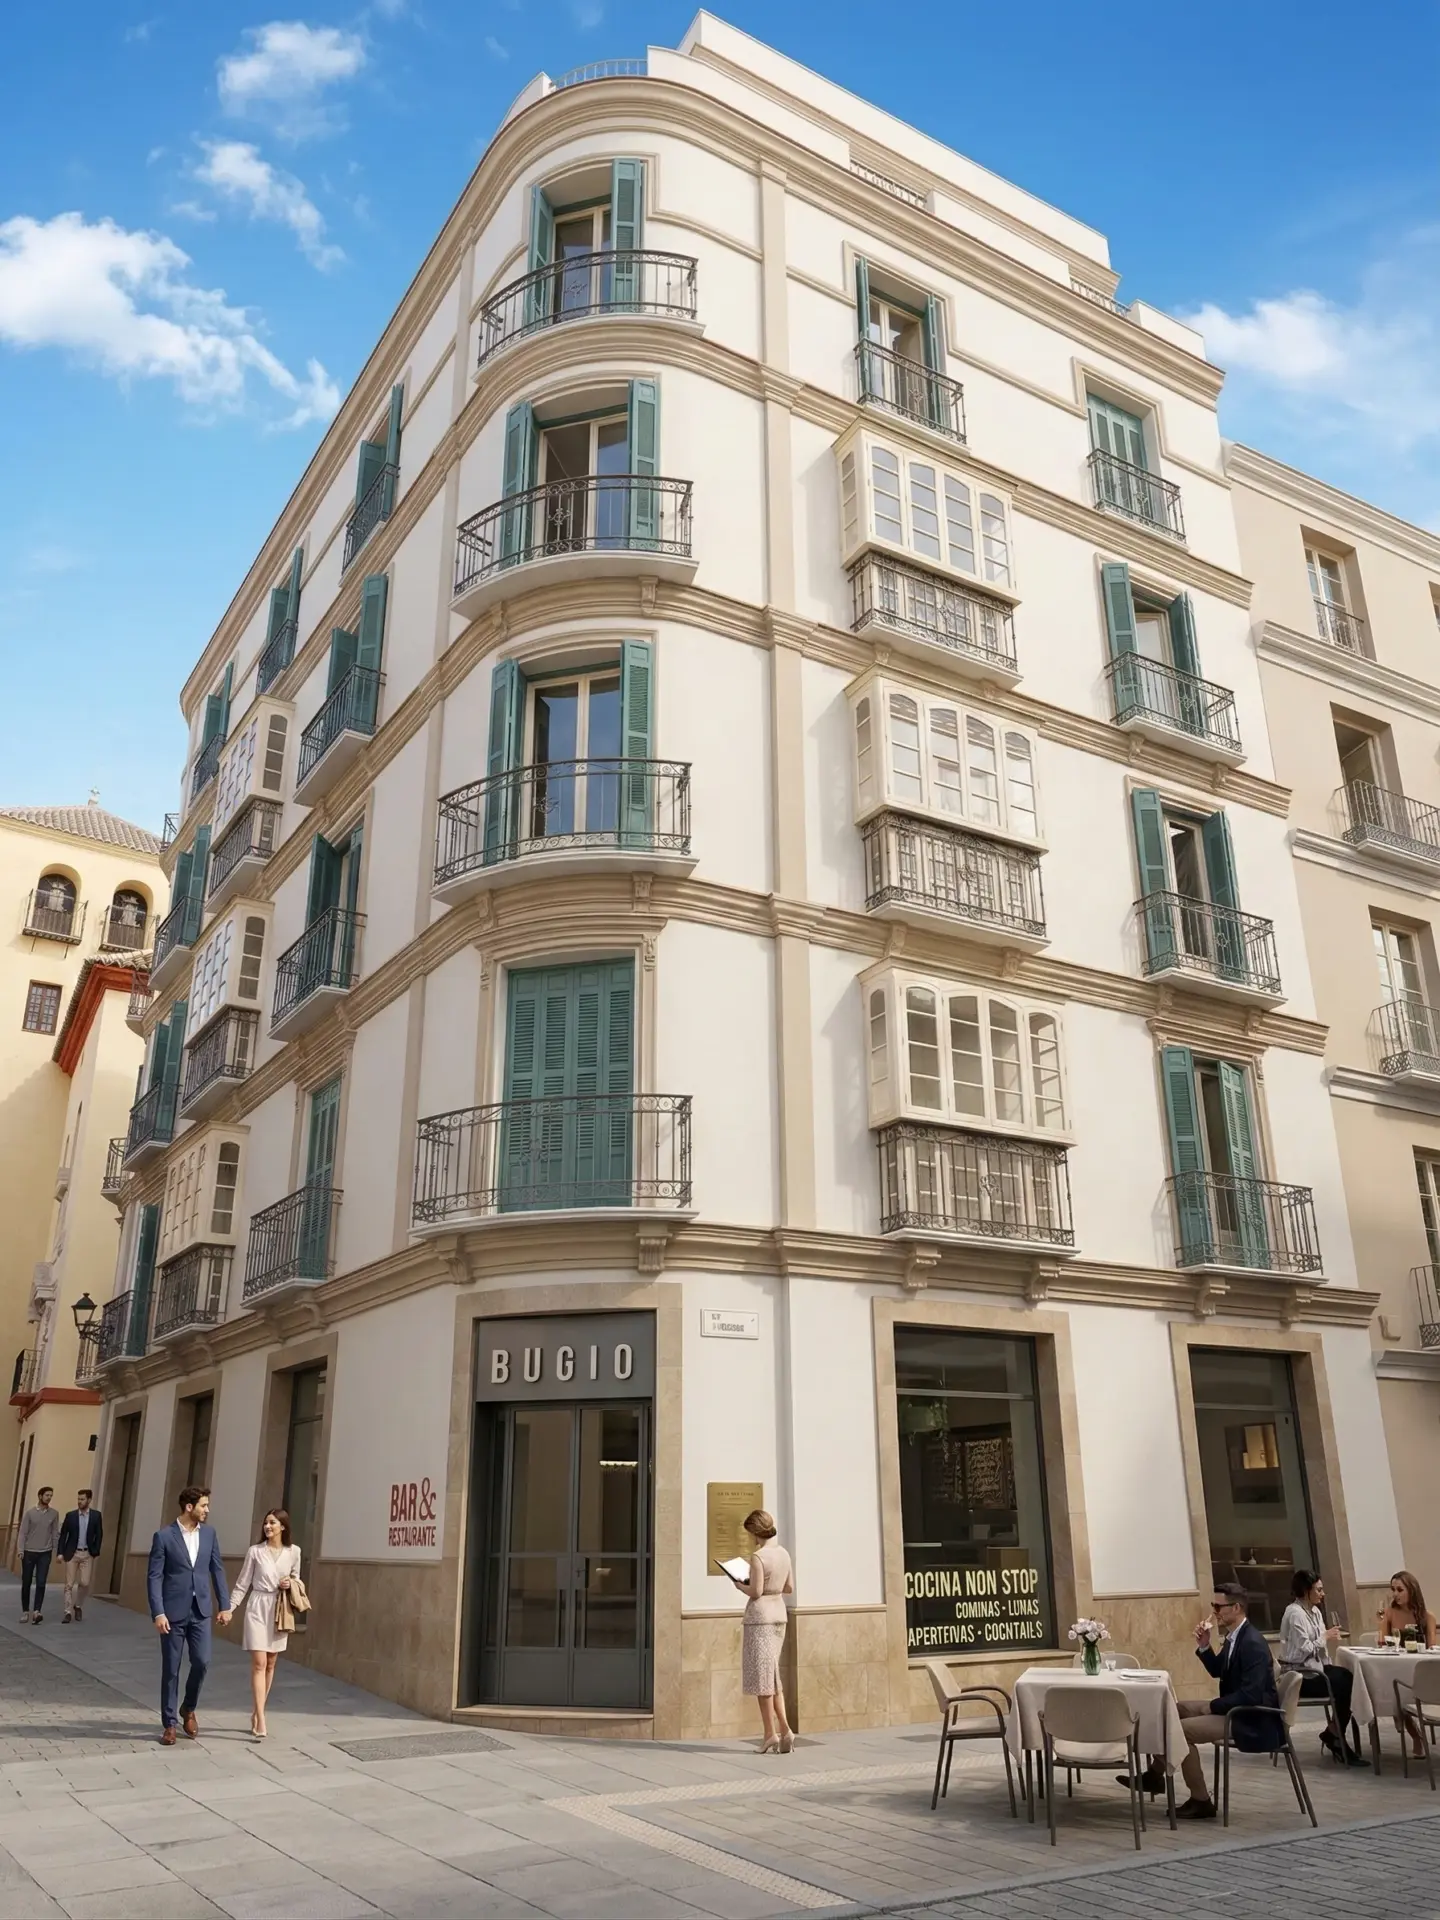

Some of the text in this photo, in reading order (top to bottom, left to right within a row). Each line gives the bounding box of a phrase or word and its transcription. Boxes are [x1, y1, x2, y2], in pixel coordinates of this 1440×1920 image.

[491, 1343, 633, 1384] BUGIO
[390, 1477, 437, 1522] BAR &
[388, 1526, 437, 1546] RESTAURANTE
[904, 1568, 1038, 1599] COCINA NON STOP
[955, 1599, 1039, 1619] COMINAS LUNAS
